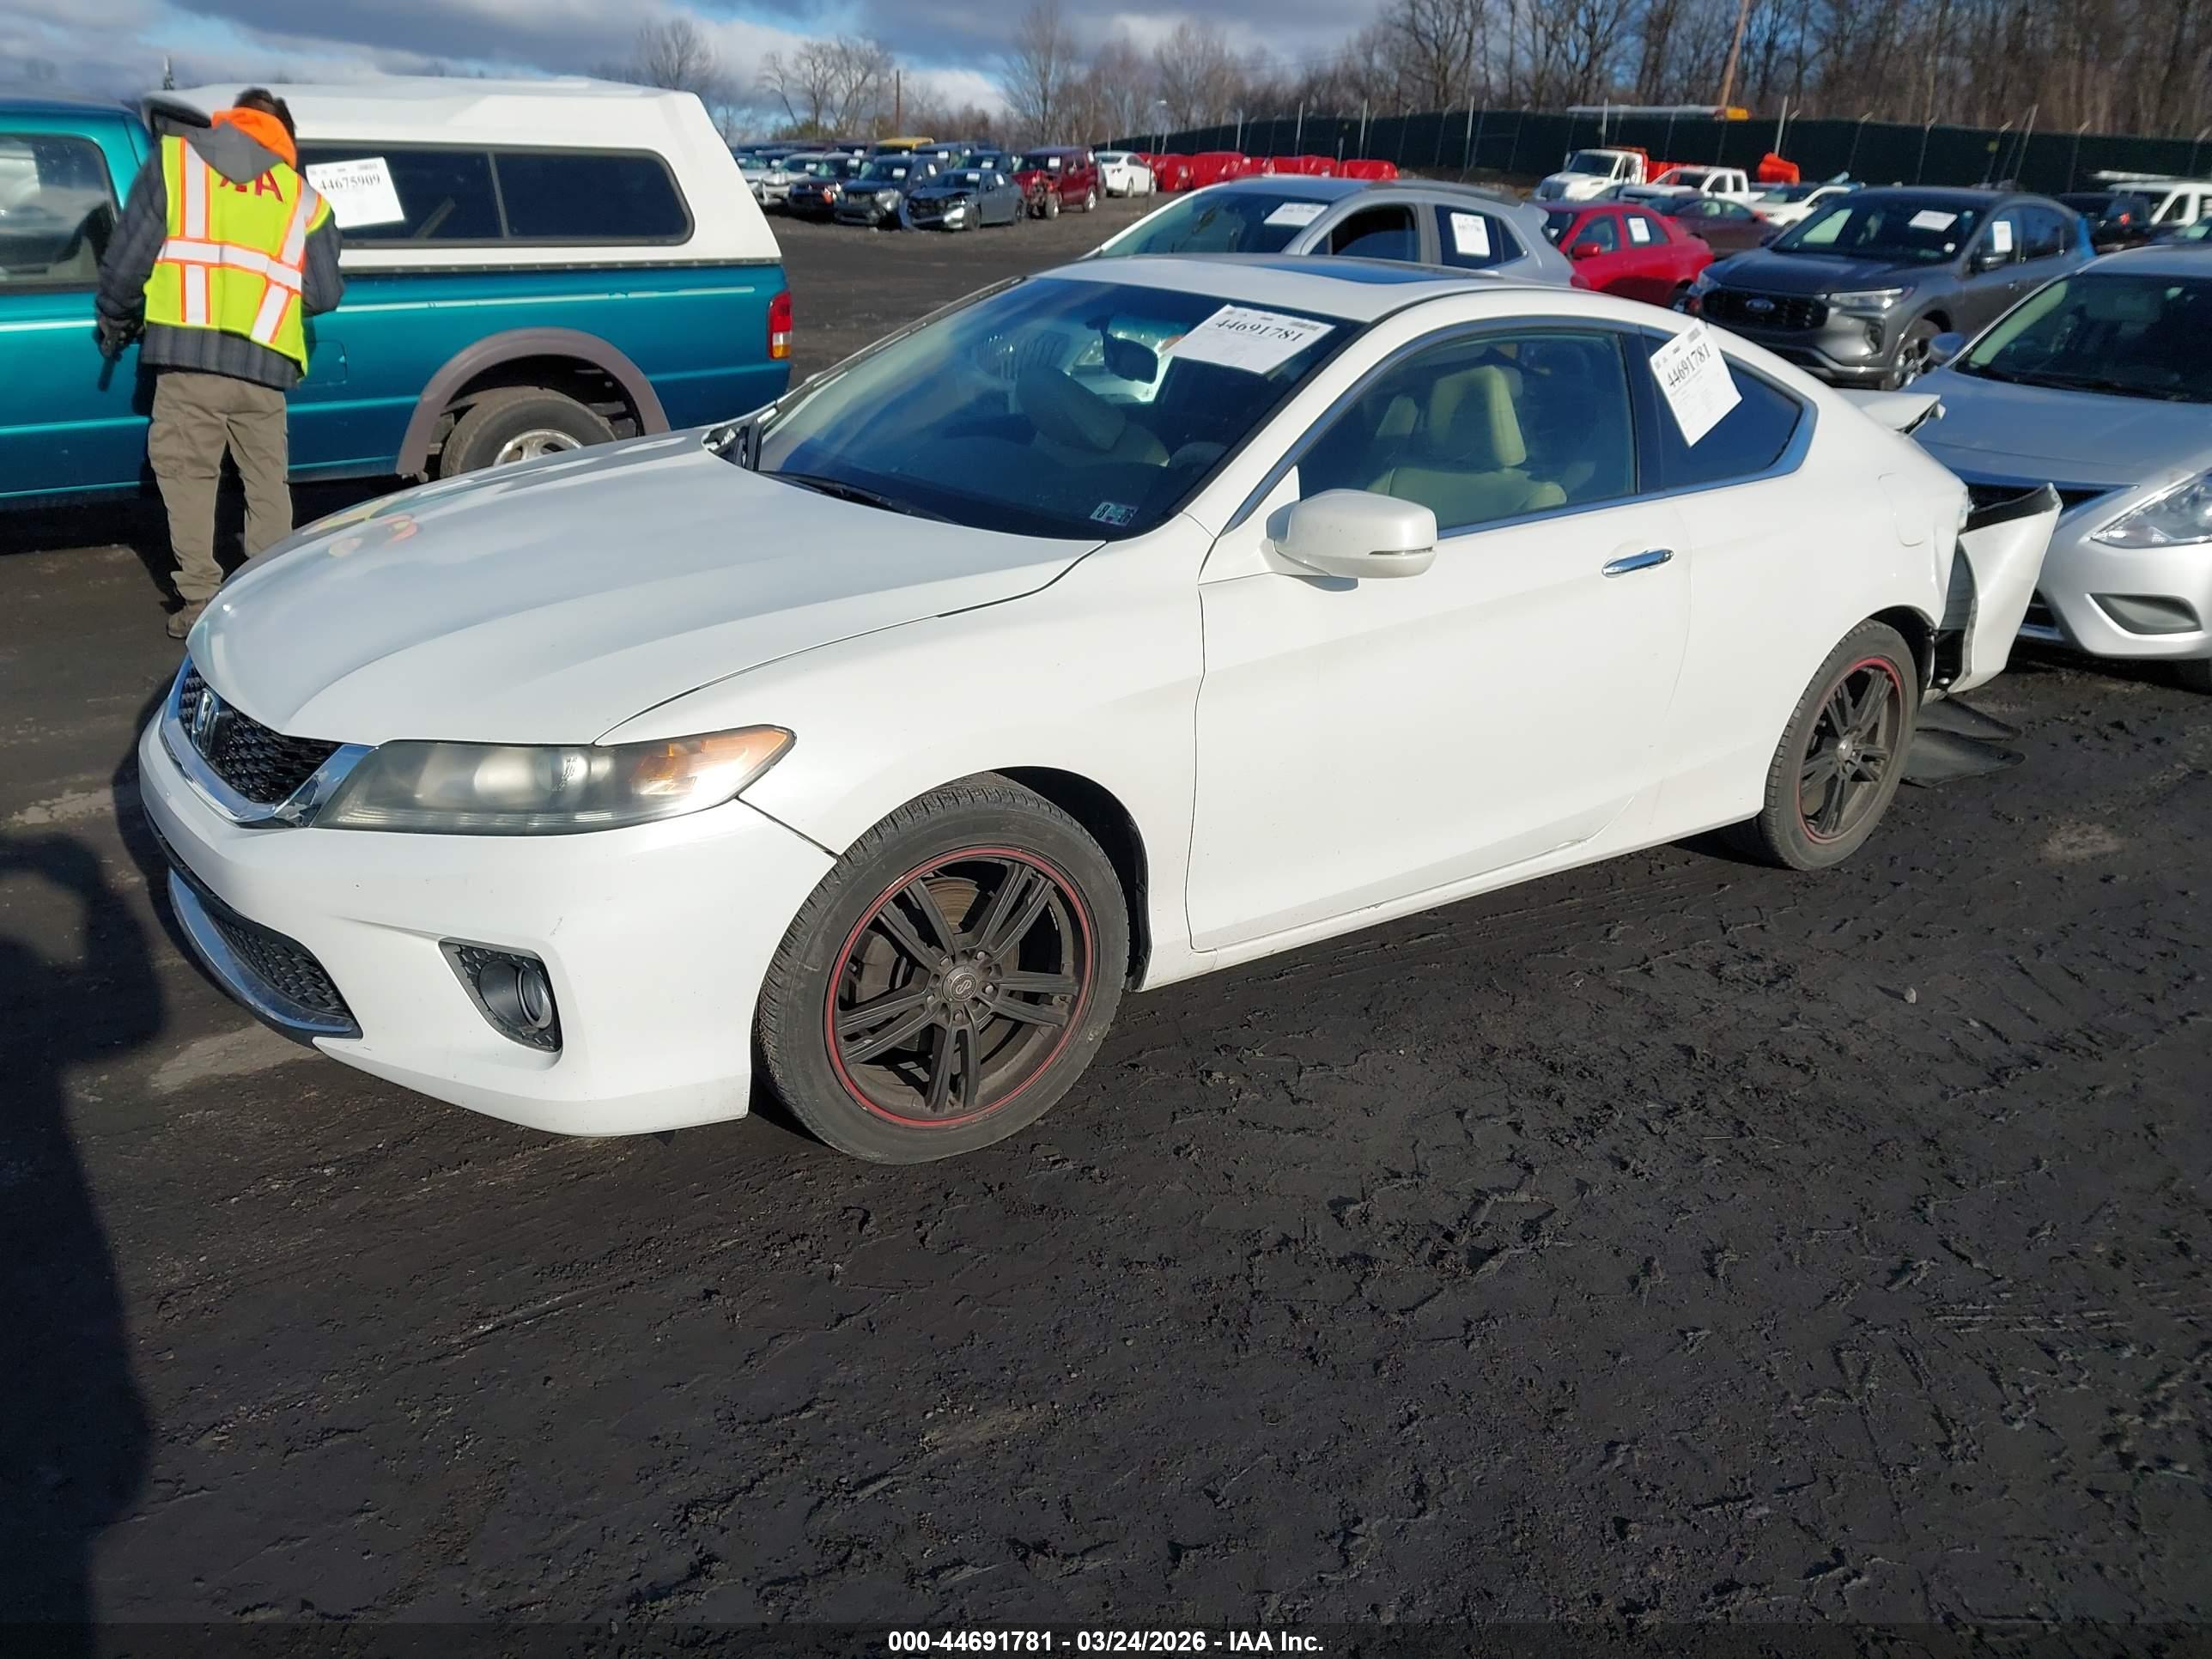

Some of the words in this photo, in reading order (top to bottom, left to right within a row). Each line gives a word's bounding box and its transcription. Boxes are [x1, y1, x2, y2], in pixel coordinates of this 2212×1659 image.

[320, 173, 380, 190] 44675909
[1215, 319, 1304, 343] 44691781
[1667, 343, 1711, 388] 44691781
